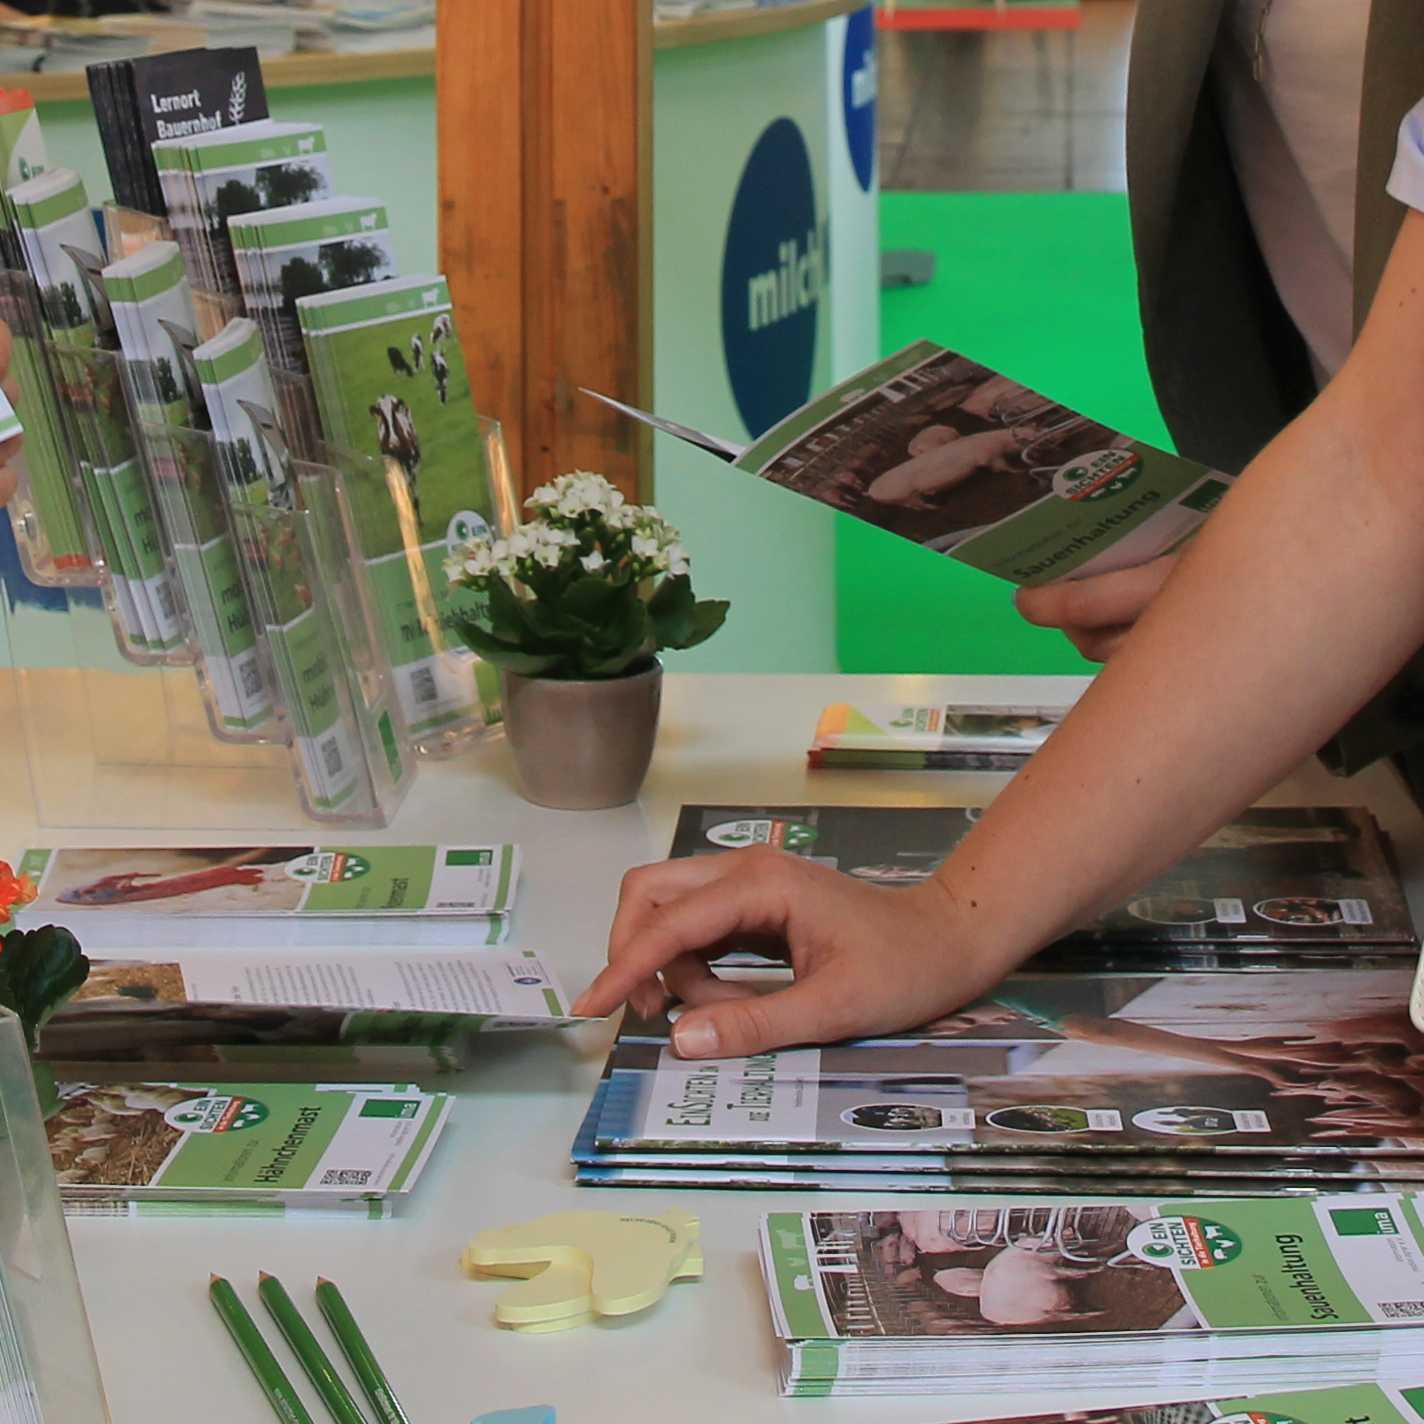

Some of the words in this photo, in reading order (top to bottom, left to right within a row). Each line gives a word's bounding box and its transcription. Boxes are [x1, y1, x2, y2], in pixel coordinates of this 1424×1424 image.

[150, 89, 202, 114] Lernort
[156, 110, 223, 139] Bauernhof
[1090, 449, 1119, 469] EIN
[1012, 488, 1162, 580] Sauenhaltung
[193, 1099, 210, 1112] EIN
[253, 1106, 322, 1184] Hähnchenmast
[1152, 1220, 1167, 1240] EIN
[1374, 1211, 1400, 1235] ima
[1170, 1221, 1198, 1267] SICHTEN
[1275, 1234, 1340, 1321] Sauenhaltung
